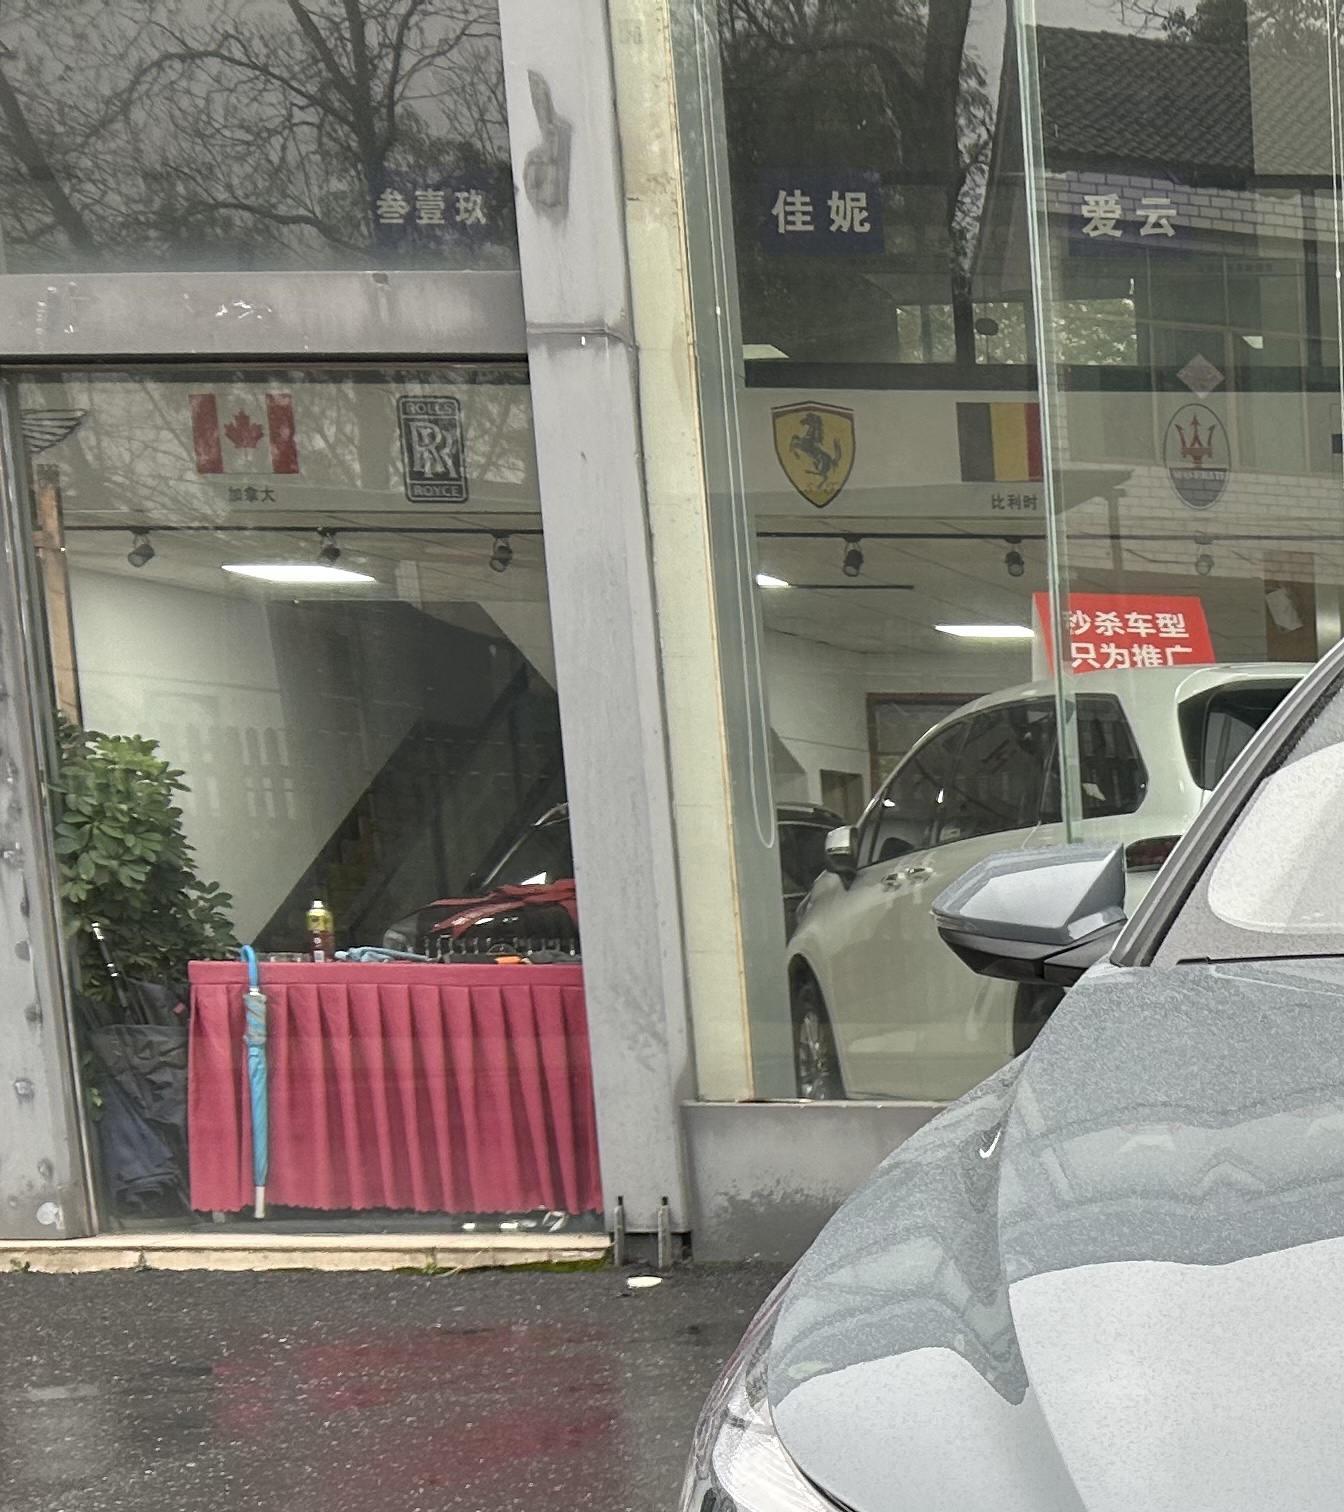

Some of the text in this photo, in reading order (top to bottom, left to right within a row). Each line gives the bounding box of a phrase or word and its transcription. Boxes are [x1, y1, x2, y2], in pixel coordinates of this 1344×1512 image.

[376, 189, 487, 225] 叁壹玖
[772, 190, 871, 234] 佳妮
[1081, 193, 1177, 238] 爱云
[228, 485, 276, 502] 加拿大
[414, 484, 459, 497] ROYCE
[991, 492, 1038, 511] 比利时
[1066, 610, 1190, 638] 秒杀车型
[1071, 642, 1192, 669] 只为推广
